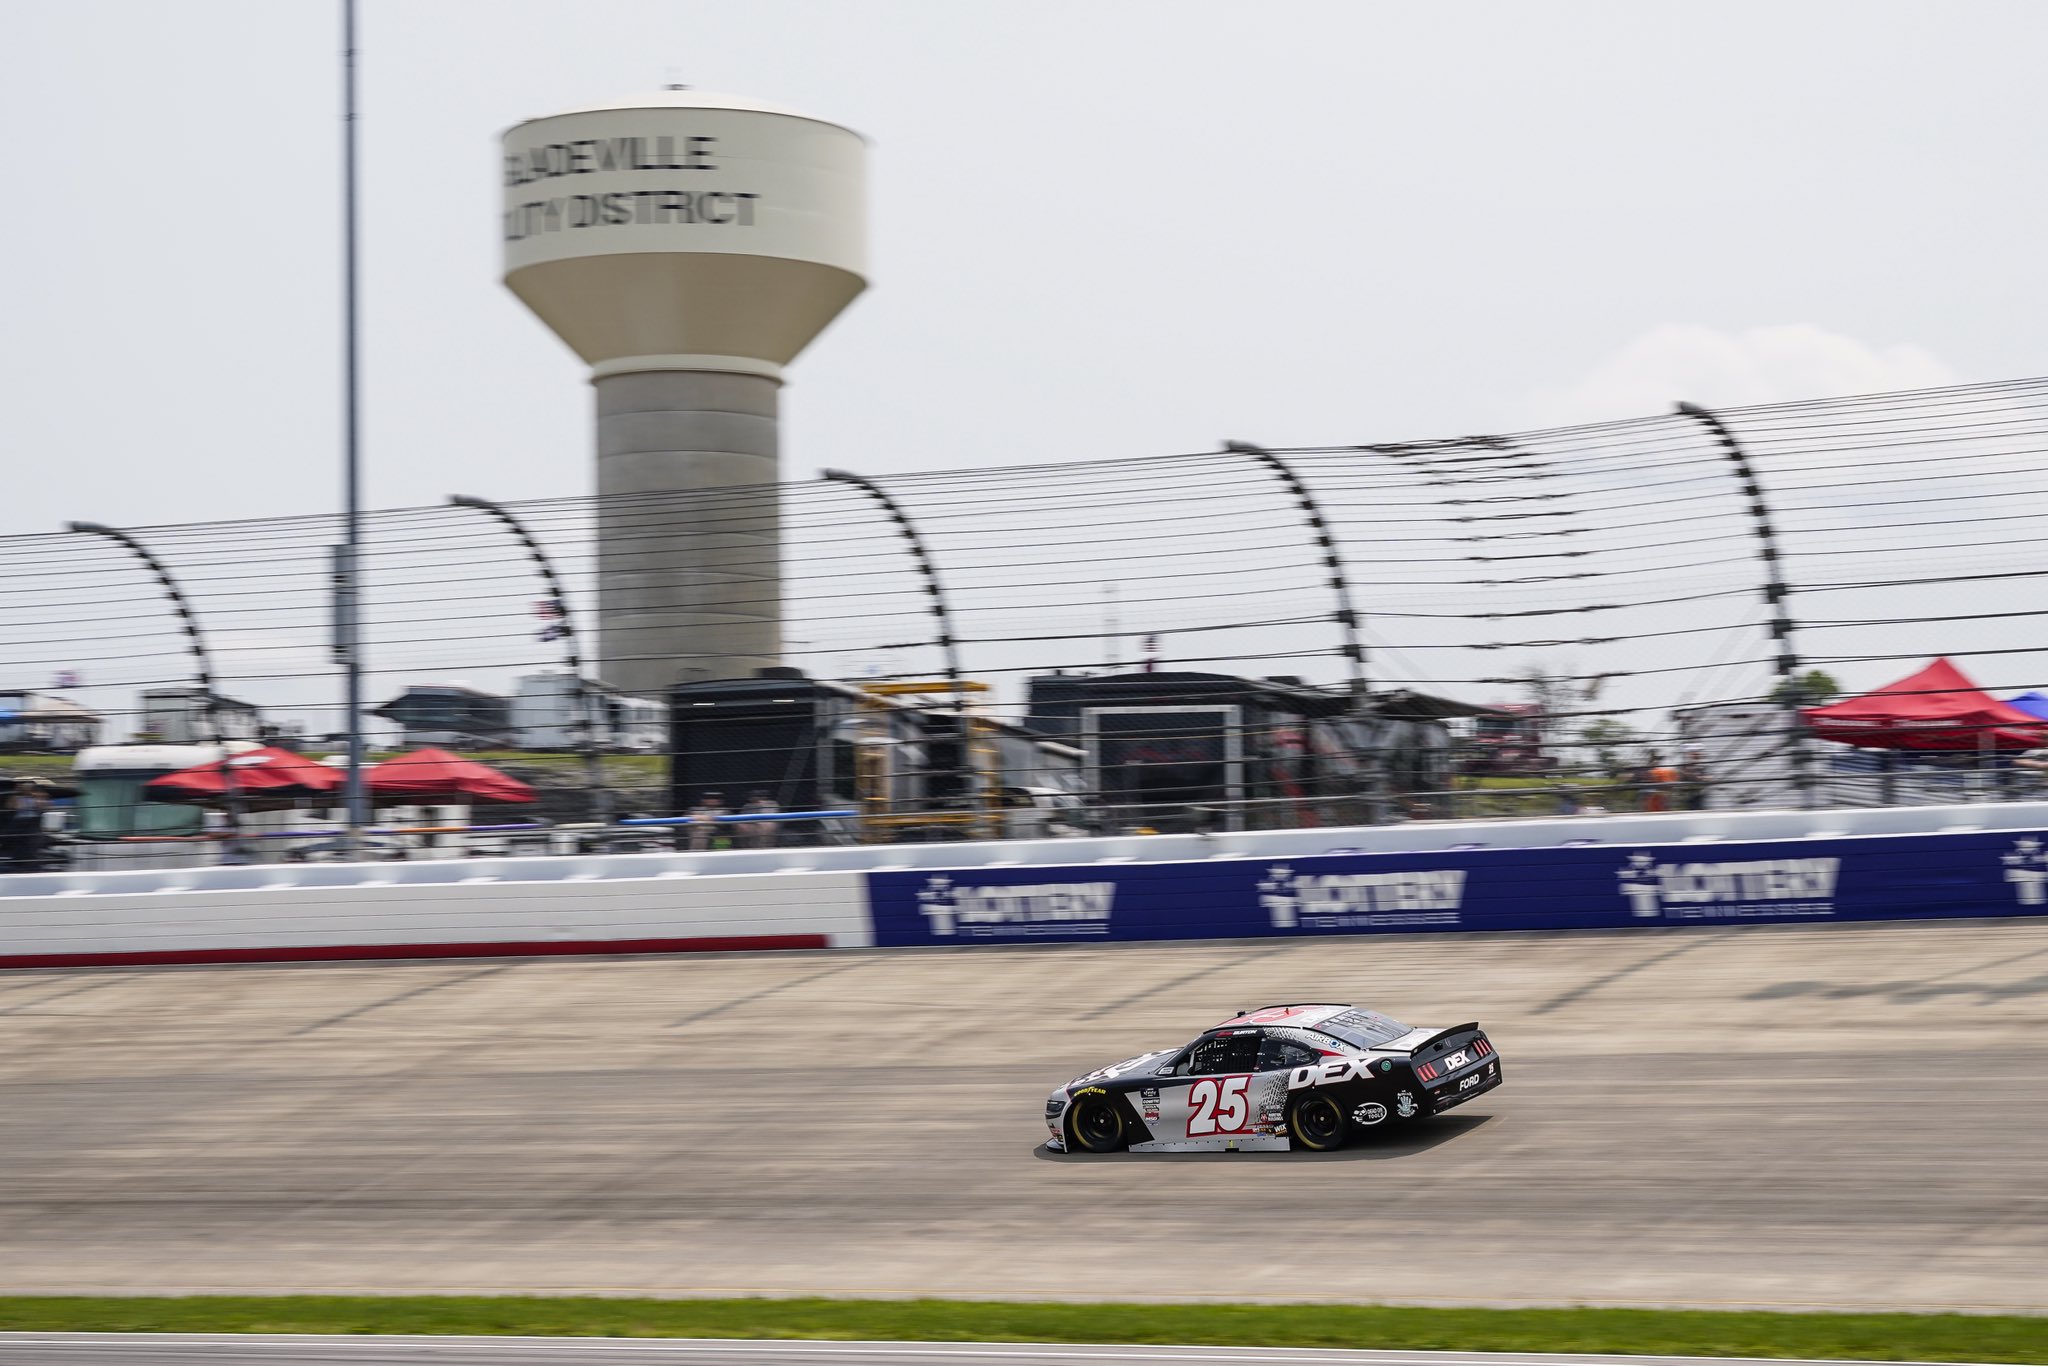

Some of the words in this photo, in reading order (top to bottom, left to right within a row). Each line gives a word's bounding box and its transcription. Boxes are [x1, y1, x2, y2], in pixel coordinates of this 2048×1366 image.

[1444, 1050, 1471, 1071] DEX
[1288, 1058, 1375, 1090] DEX
[1459, 1073, 1480, 1092] FORD
[1073, 1086, 1107, 1097] GOODYEAR
[1186, 1074, 1253, 1138] 25
